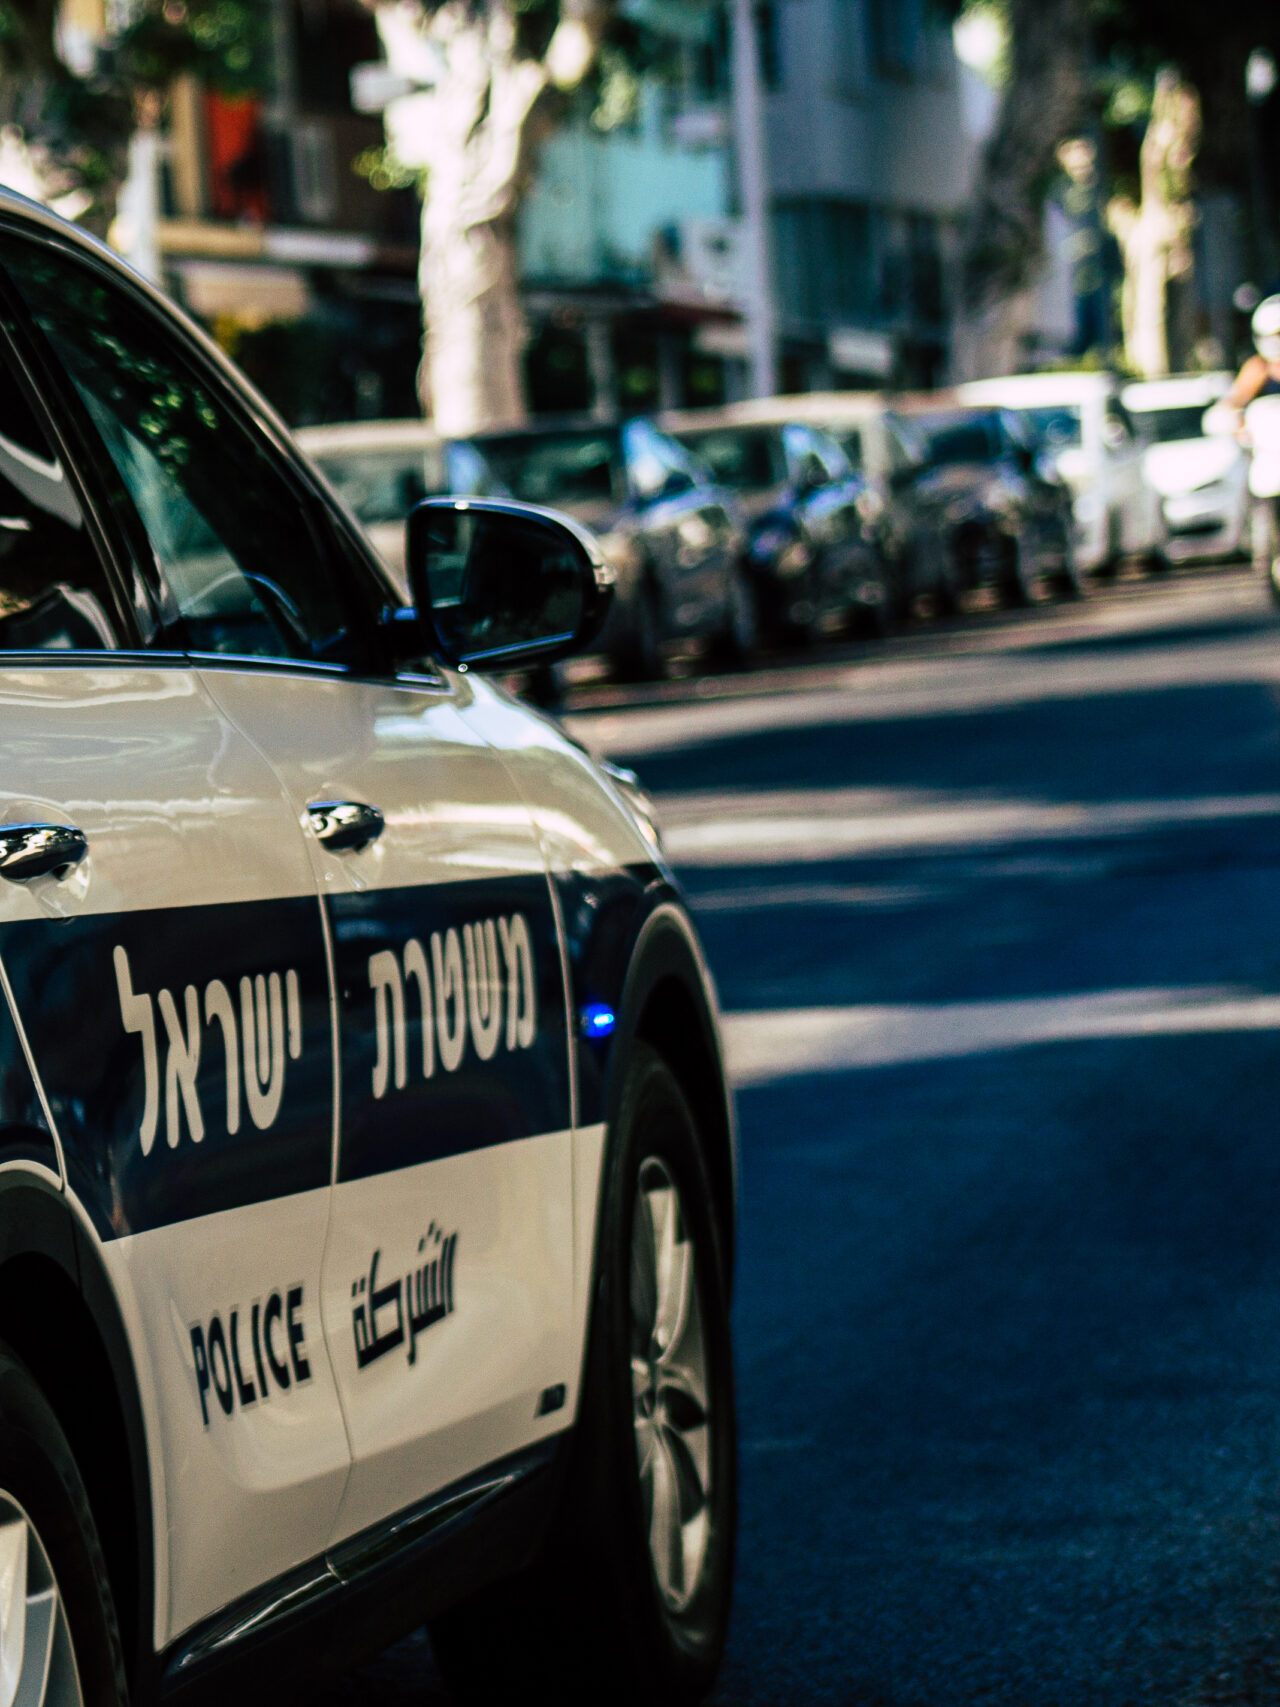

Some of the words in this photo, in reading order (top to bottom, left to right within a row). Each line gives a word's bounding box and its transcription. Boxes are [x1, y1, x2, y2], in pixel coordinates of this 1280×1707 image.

[113, 945, 301, 1157] ישראל
[368, 913, 536, 1099] משטרת
[188, 1284, 312, 1428] POLICE
[351, 1219, 458, 1369] الشرطة
